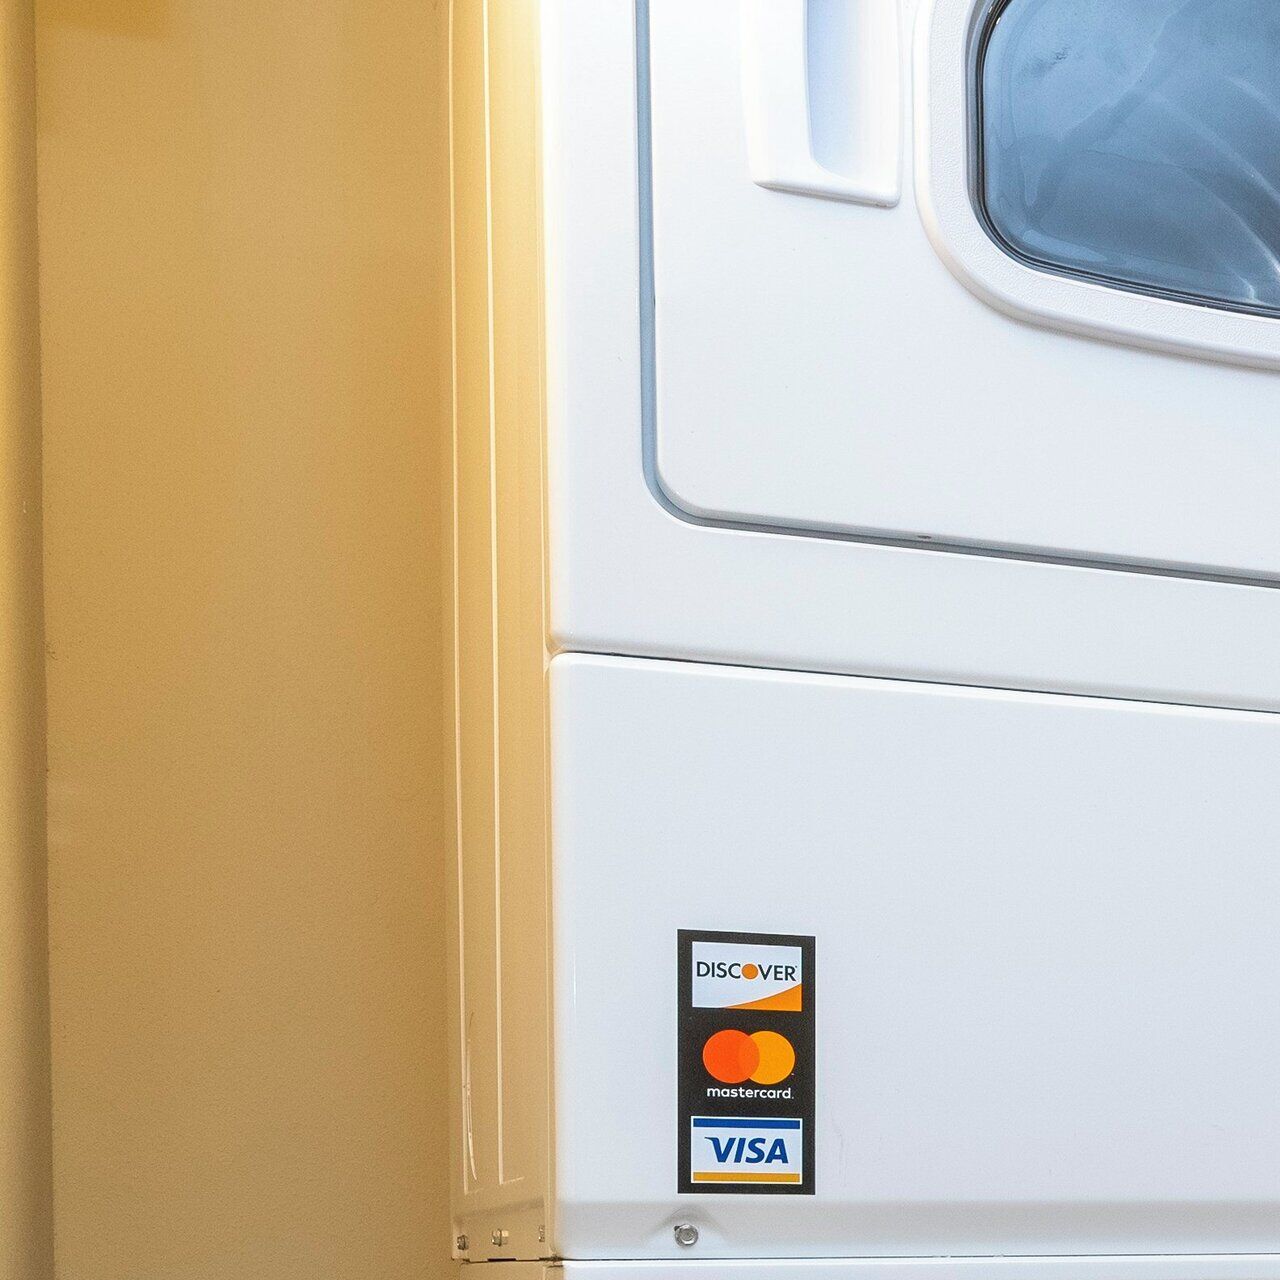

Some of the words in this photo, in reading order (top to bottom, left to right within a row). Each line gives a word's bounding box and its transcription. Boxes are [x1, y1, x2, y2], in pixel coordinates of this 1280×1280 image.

[696, 961, 798, 982] DISCOVER
[707, 1087, 791, 1099] mastercard
[704, 1137, 789, 1164] VISA
